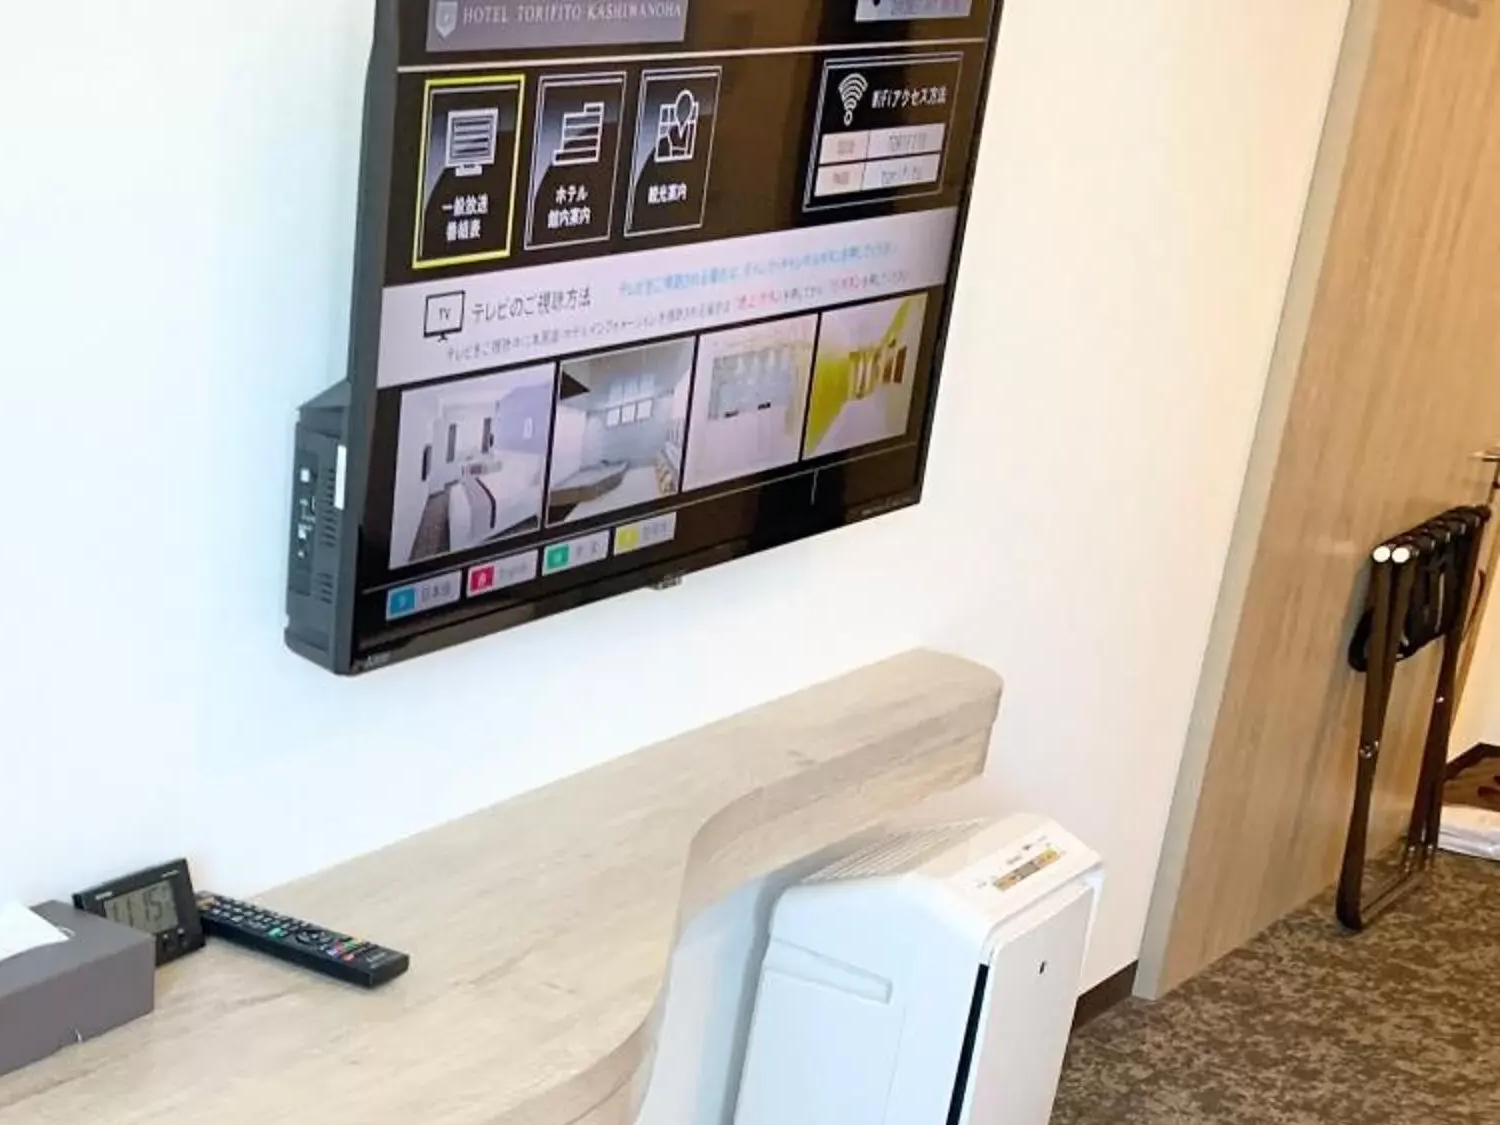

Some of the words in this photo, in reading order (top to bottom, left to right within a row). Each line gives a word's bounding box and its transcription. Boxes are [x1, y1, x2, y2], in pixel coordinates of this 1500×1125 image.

[462, 6, 508, 25] HOTEL
[555, 184, 588, 204] ホテル
